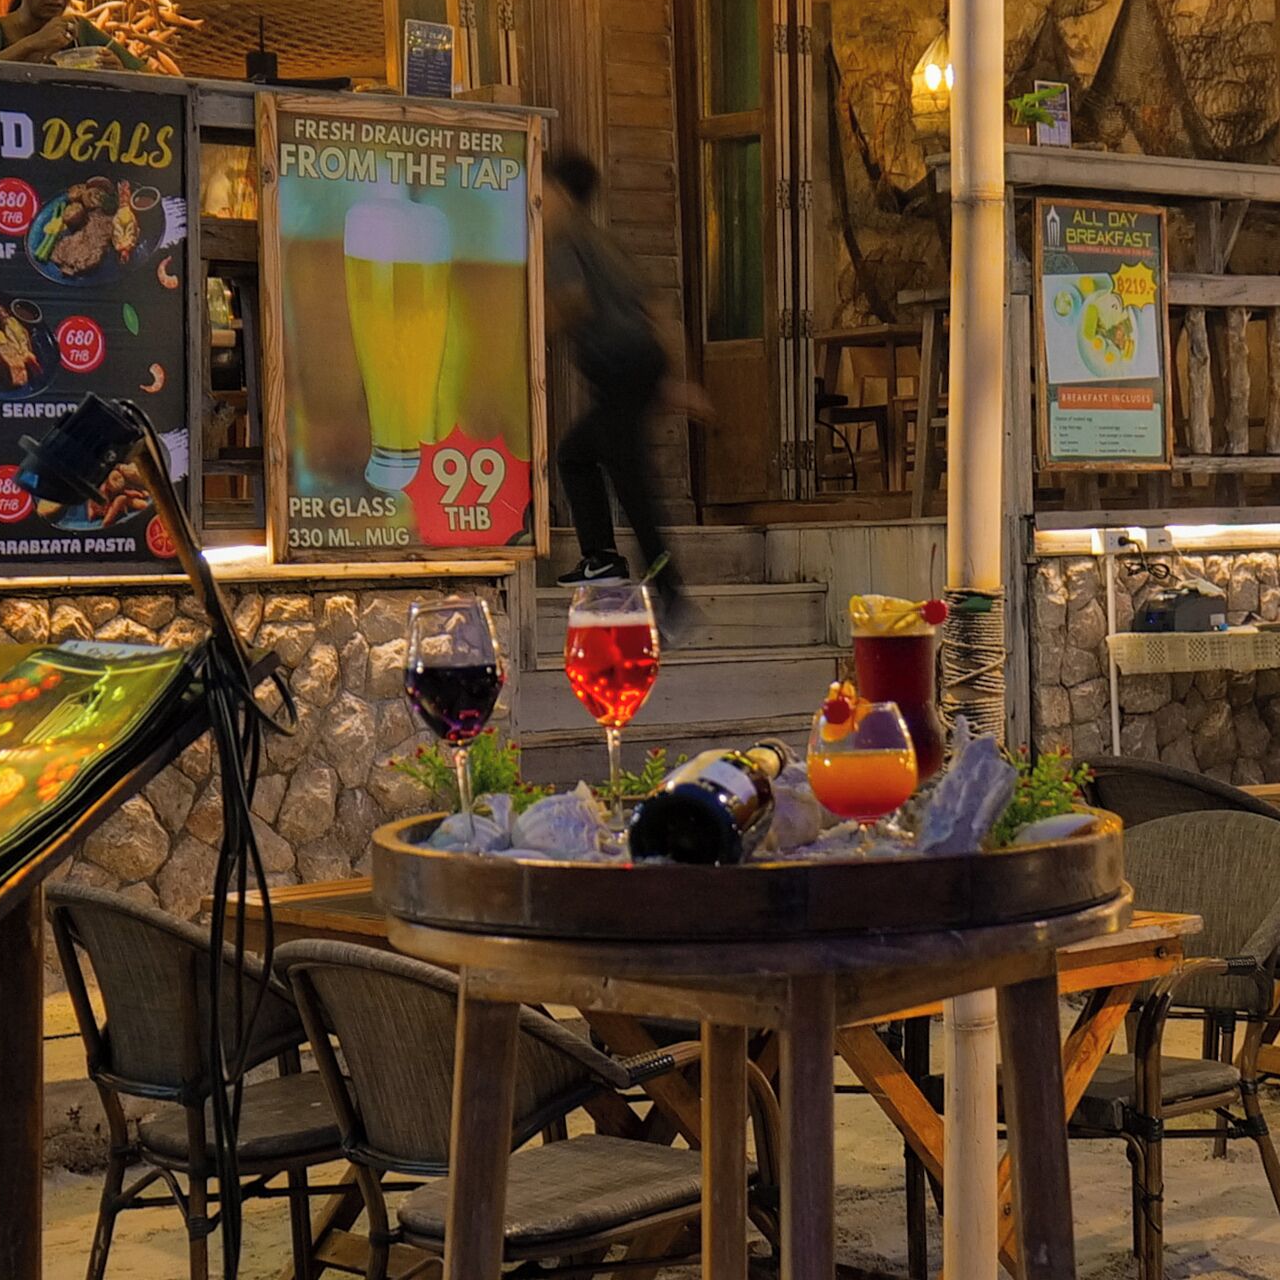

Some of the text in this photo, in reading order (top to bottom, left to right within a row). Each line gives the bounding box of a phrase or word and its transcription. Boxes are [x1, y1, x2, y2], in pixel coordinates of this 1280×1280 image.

[39, 117, 174, 168] DEALS
[294, 119, 503, 152] FRESH DRAUGHT BEER
[280, 143, 519, 190] FROM THE TAP
[2, 213, 24, 224] THB
[1073, 209, 1138, 228] ALL DAY
[1066, 228, 1152, 248] BREAKFAST
[66, 329, 94, 345] 680
[69, 349, 90, 362] THB
[432, 448, 506, 504] 99
[289, 496, 396, 518] PER GLASS
[445, 506, 491, 531] THB
[84, 538, 136, 554] PASTA
[289, 527, 410, 547] 330 ML. MUG
